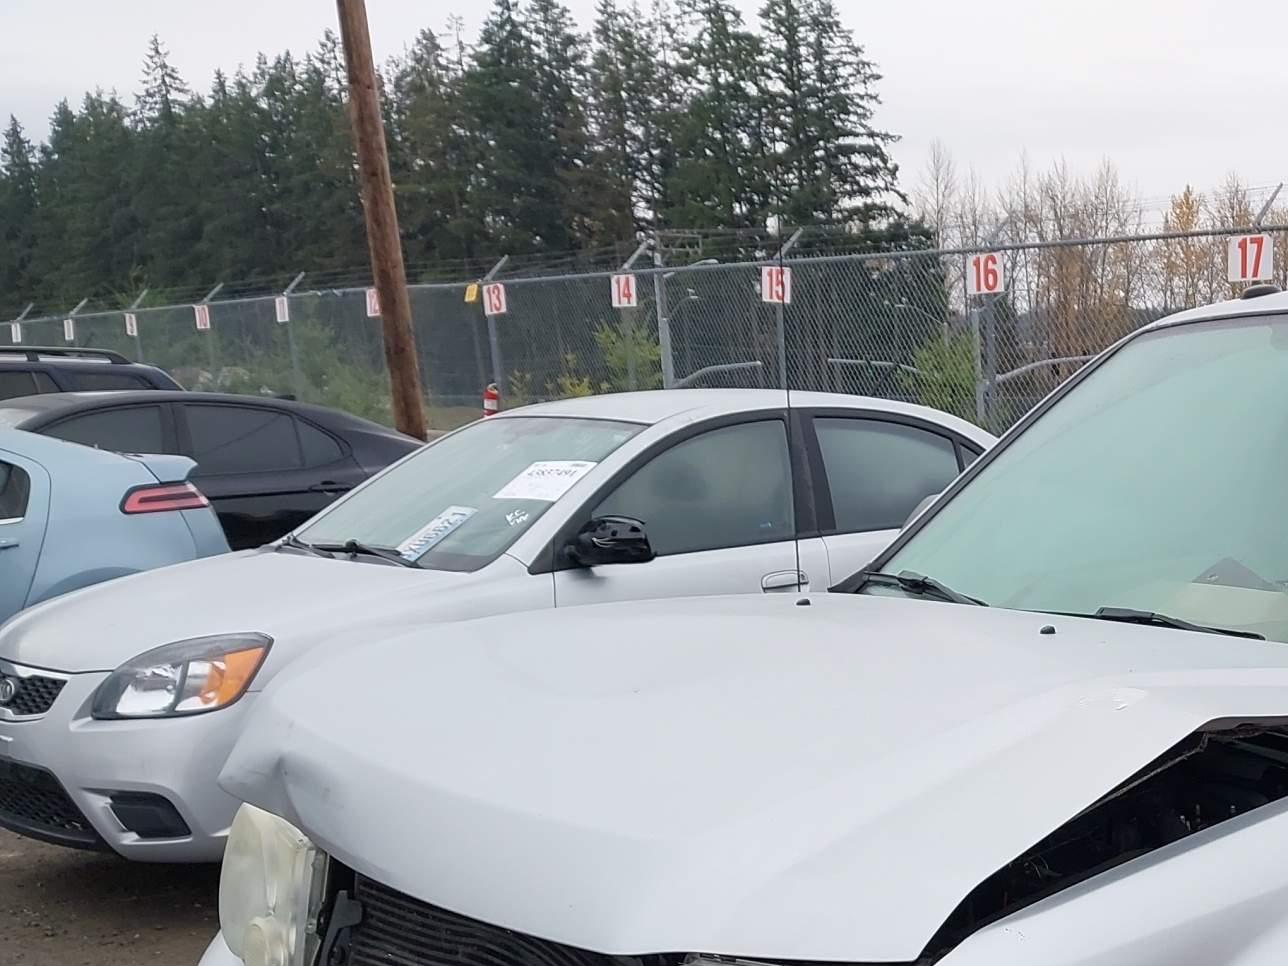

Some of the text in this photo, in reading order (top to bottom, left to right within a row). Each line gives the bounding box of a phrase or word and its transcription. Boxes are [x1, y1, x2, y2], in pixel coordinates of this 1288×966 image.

[972, 253, 998, 294] 16
[1237, 236, 1266, 280] 17
[486, 284, 502, 313] 13
[614, 277, 633, 305] 14
[766, 267, 786, 301] 15
